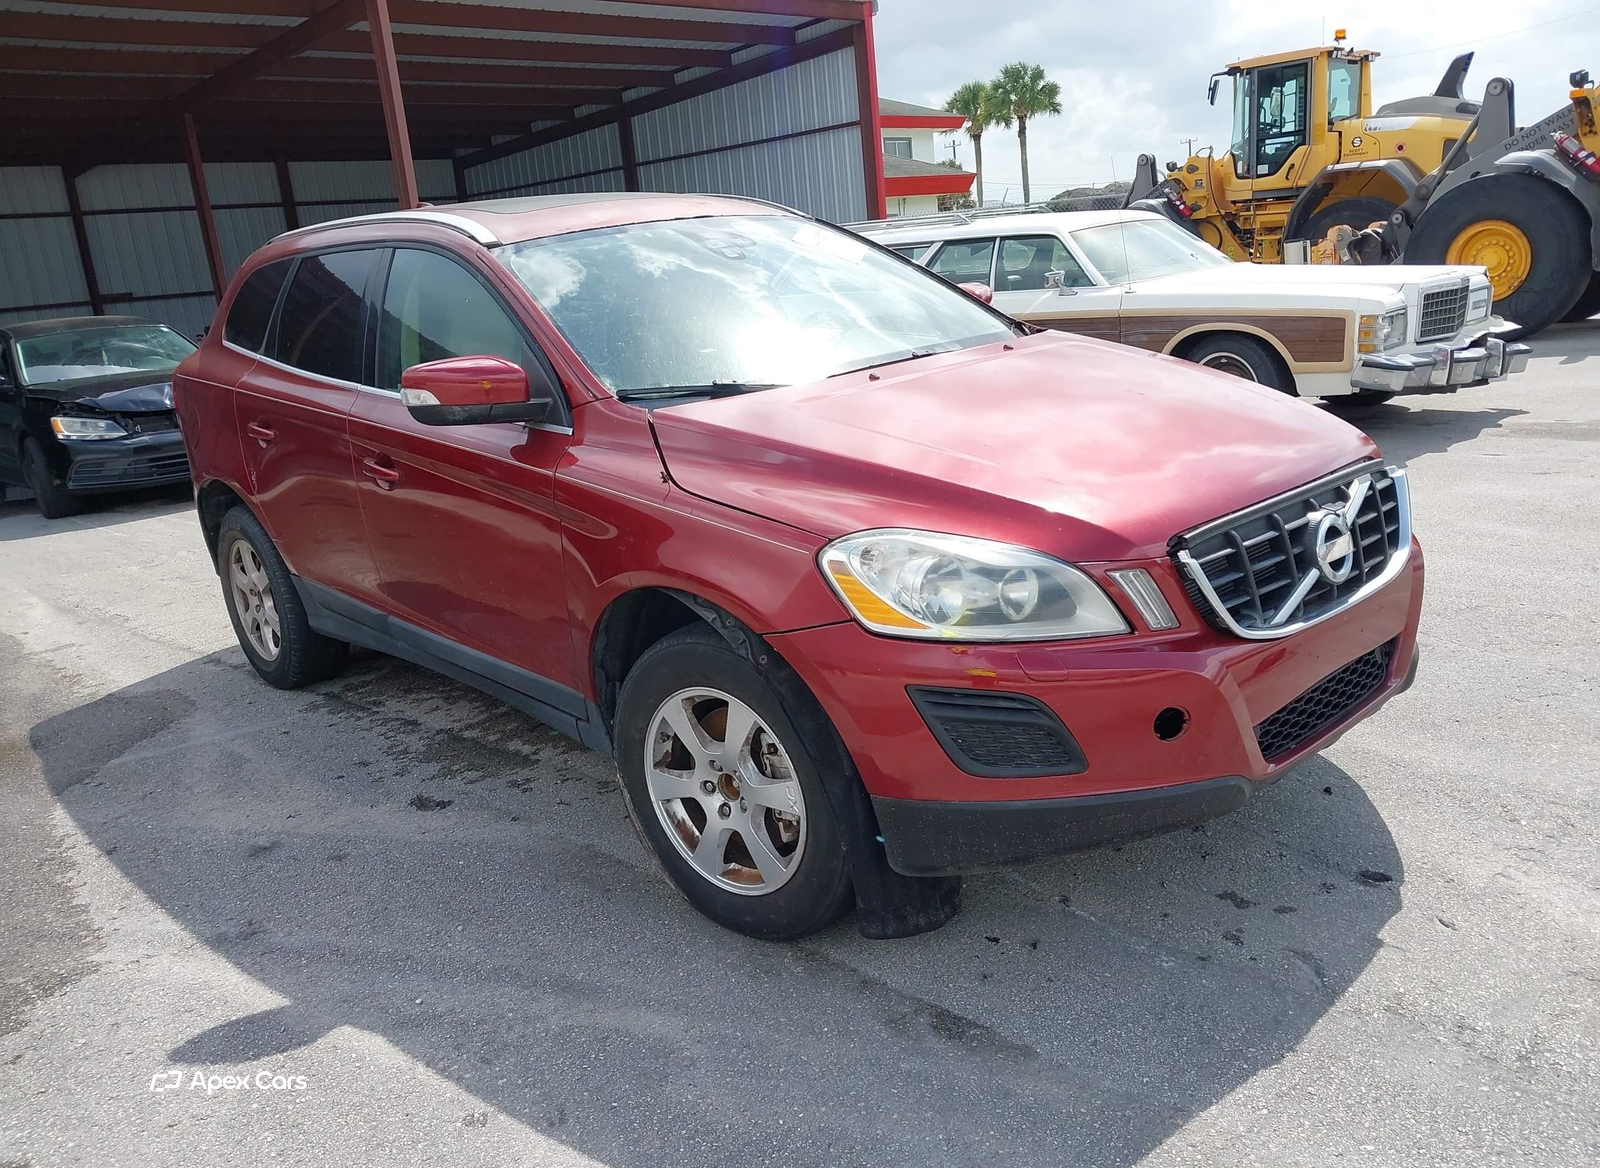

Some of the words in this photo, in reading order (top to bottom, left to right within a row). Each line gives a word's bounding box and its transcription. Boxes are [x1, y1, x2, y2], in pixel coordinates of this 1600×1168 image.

[1504, 138, 1519, 151] DO
[1521, 124, 1542, 141] NOT
[1544, 106, 1575, 127] WALK
[1518, 134, 1547, 151] NDER
